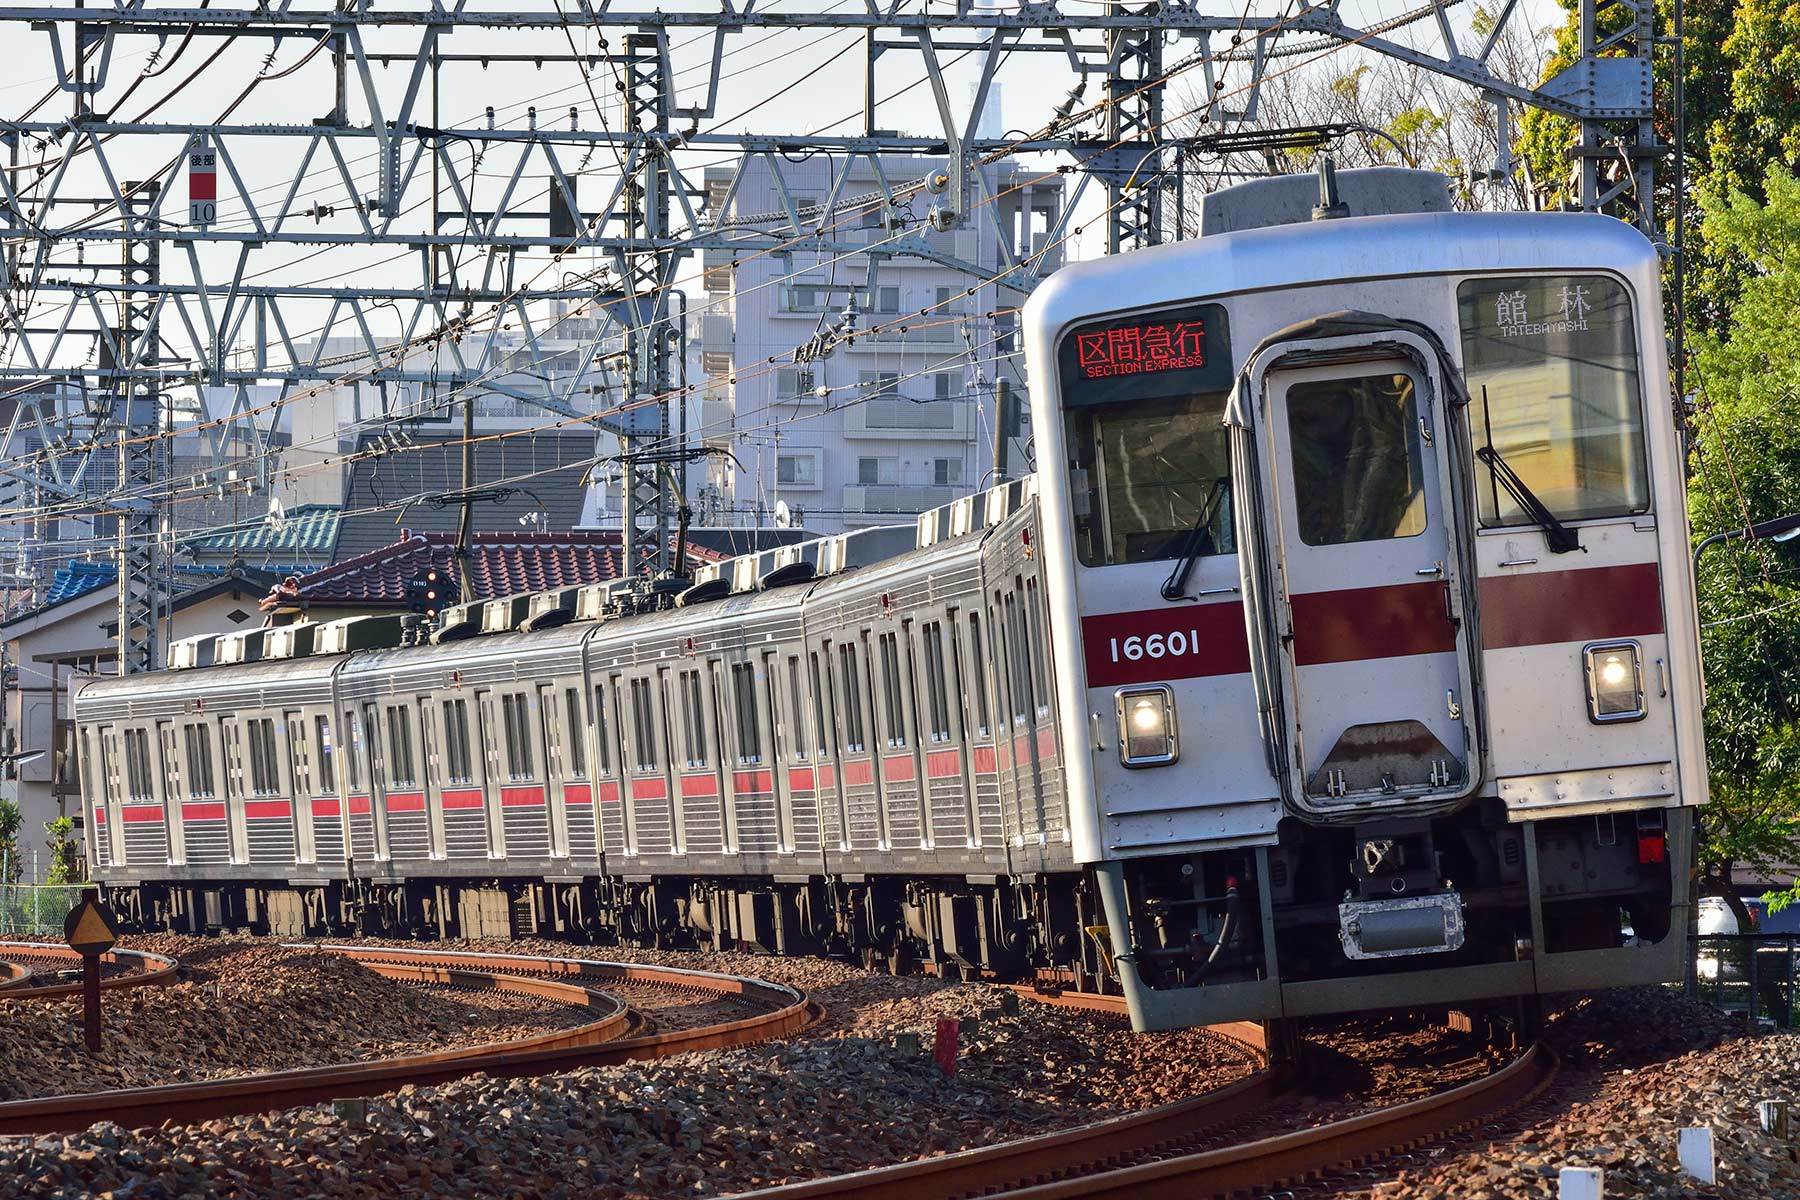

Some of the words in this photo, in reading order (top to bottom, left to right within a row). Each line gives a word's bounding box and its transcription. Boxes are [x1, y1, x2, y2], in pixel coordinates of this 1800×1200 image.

[191, 154, 215, 166] 後部
[191, 203, 215, 221] 10
[1501, 320, 1588, 337] TATEBAYASHI
[1077, 321, 1205, 367] 区間急行
[1086, 362, 1141, 378] SECTION
[1145, 355, 1203, 372] EXPRESS
[1110, 629, 1199, 662] 16601
